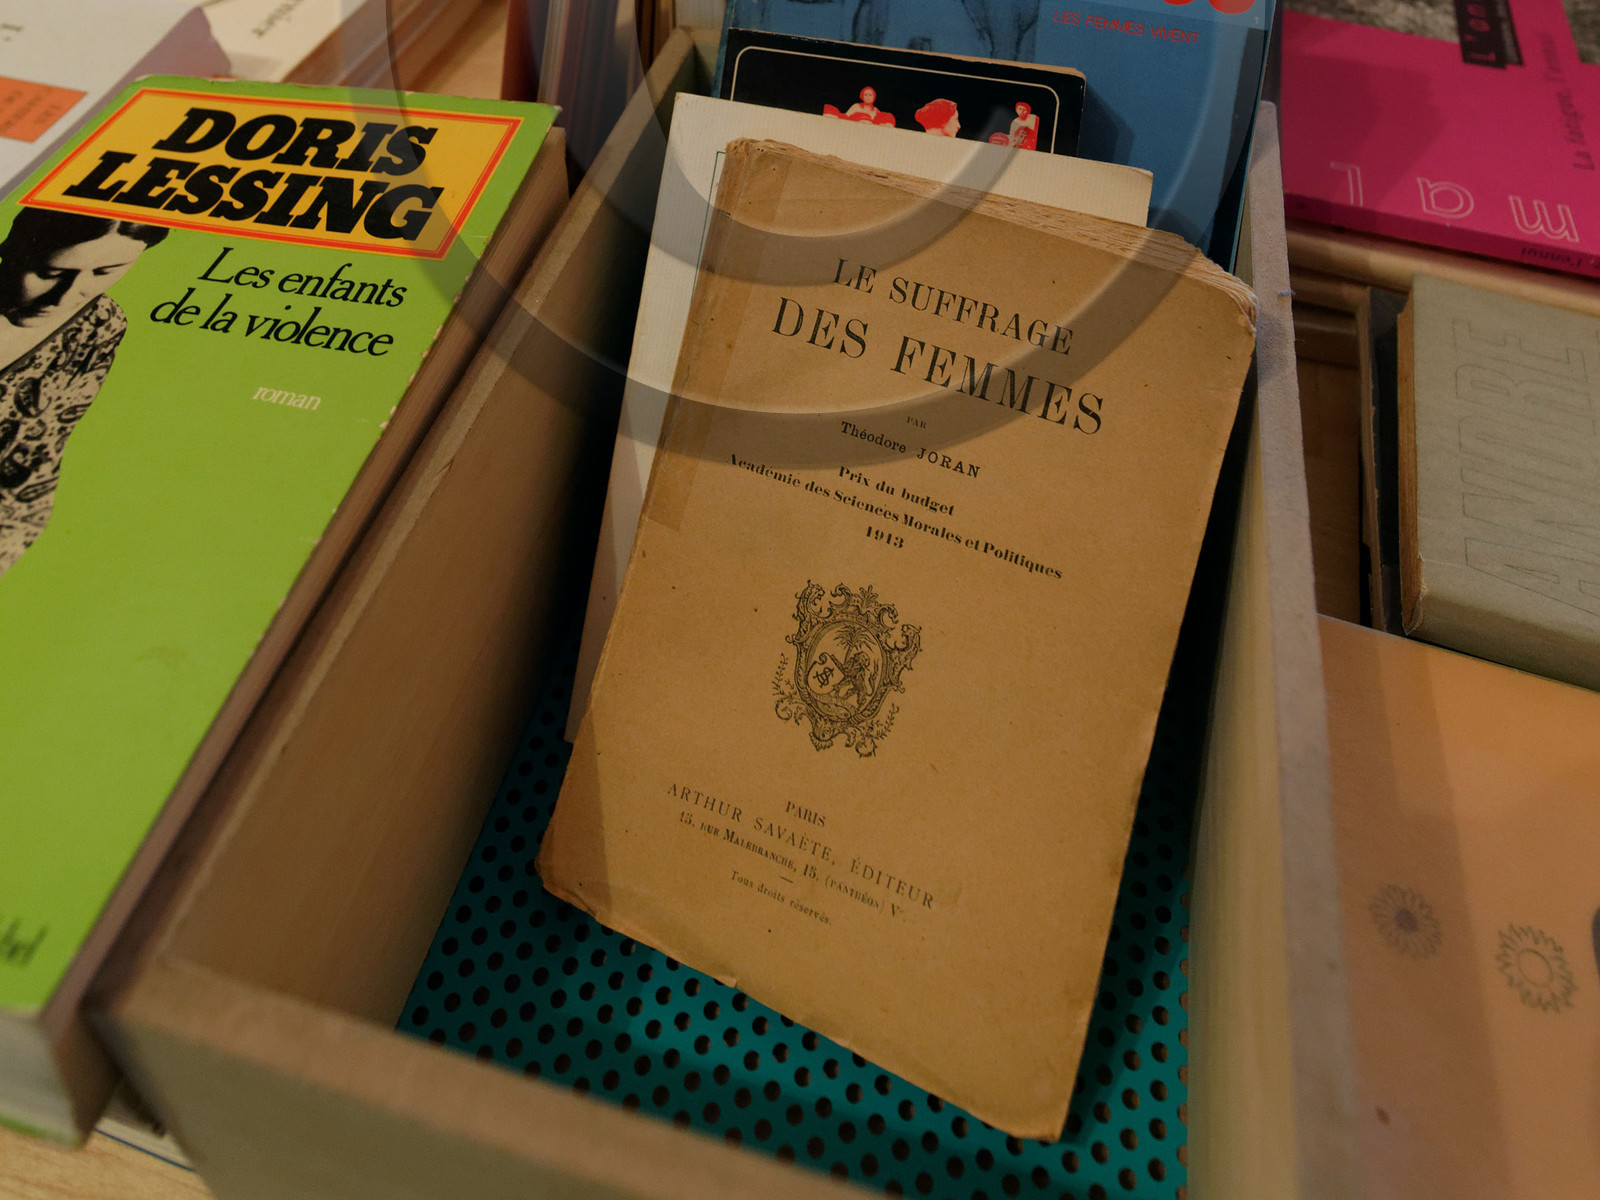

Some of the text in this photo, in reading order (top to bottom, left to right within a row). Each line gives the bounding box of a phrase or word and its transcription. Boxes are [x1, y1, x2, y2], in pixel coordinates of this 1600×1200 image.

[1053, 10, 1200, 44] LES FEMMES VIVENT
[152, 108, 439, 176] DORIS
[62, 150, 444, 241] LESSING
[198, 247, 407, 307] Les enfants
[150, 287, 394, 356] de la violence
[832, 258, 1074, 355] LE SUFFRAGE
[771, 297, 1104, 435] DES FEMMES
[252, 387, 321, 410] roman
[906, 416, 927, 429] PAR
[841, 421, 980, 478] Théodore JORAN
[727, 453, 1063, 580] Académie des Sciences Morales et Politiques
[839, 465, 954, 517] Prix du budget
[865, 526, 904, 549] 1913
[785, 801, 826, 828] PARIS
[667, 783, 742, 823] ARTHUR
[850, 856, 934, 909] ÉDITEUR
[731, 869, 753, 889] Tous
[757, 883, 785, 903] droits
